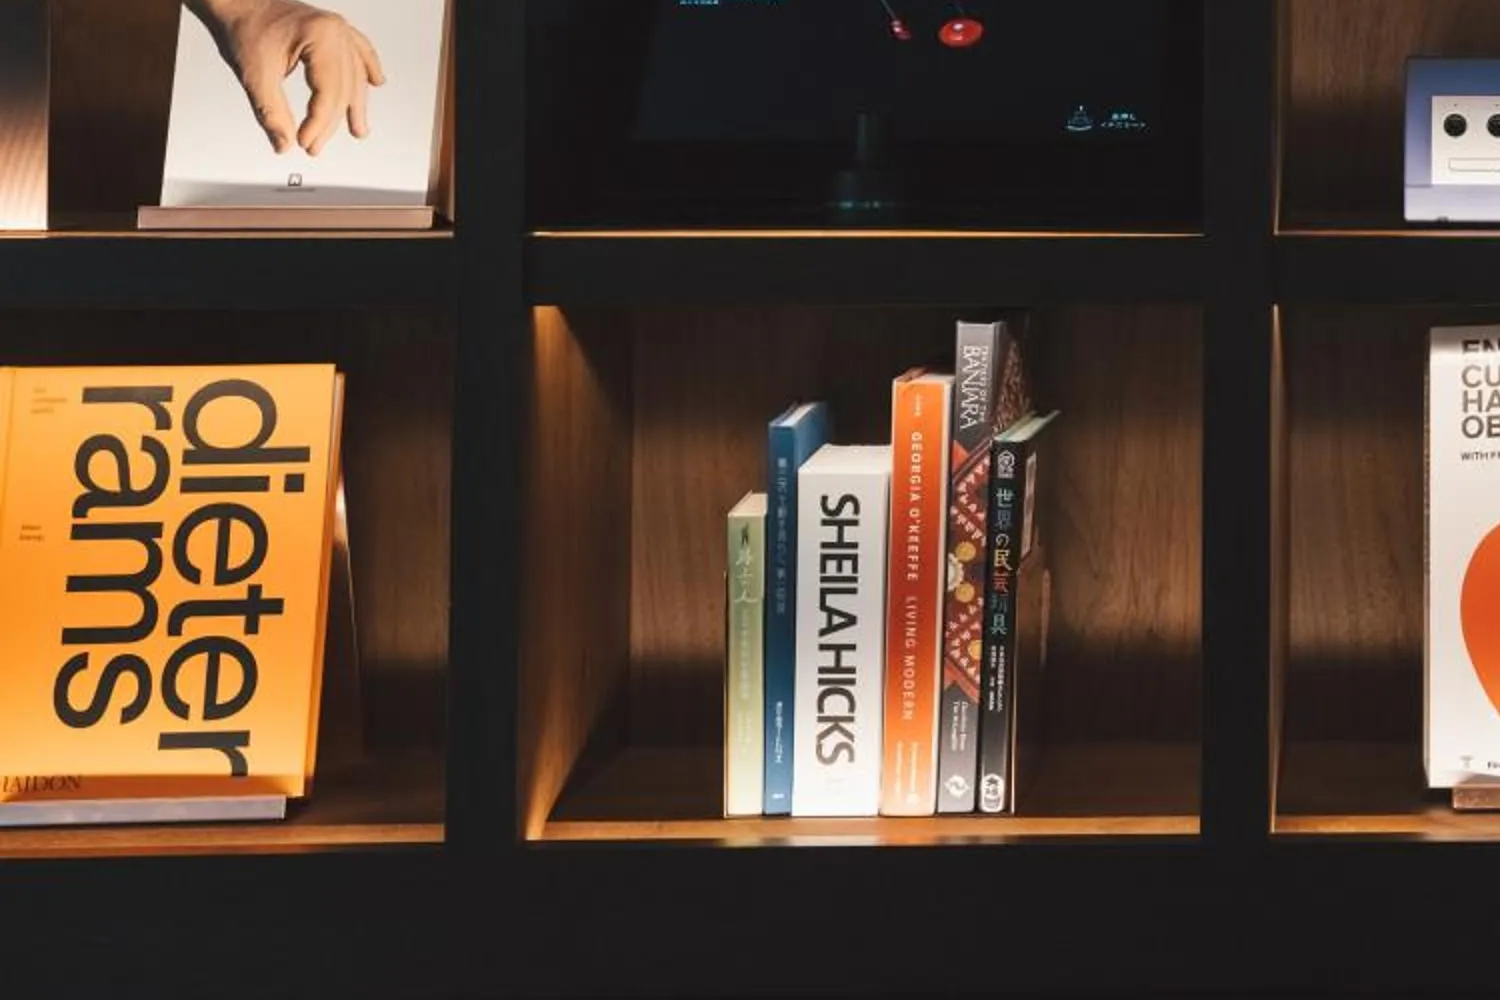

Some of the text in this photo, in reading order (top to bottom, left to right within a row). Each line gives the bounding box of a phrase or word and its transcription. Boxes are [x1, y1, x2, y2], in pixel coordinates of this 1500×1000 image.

[959, 345, 982, 431] BANJARA
[909, 431, 923, 503] GEORGIA
[1460, 450, 1488, 461] WITH
[53, 385, 174, 729] rams
[158, 378, 311, 778] dieter
[816, 493, 860, 766] SHEILA HICKS
[904, 596, 918, 648] LIVING
[901, 655, 916, 721] MODERN
